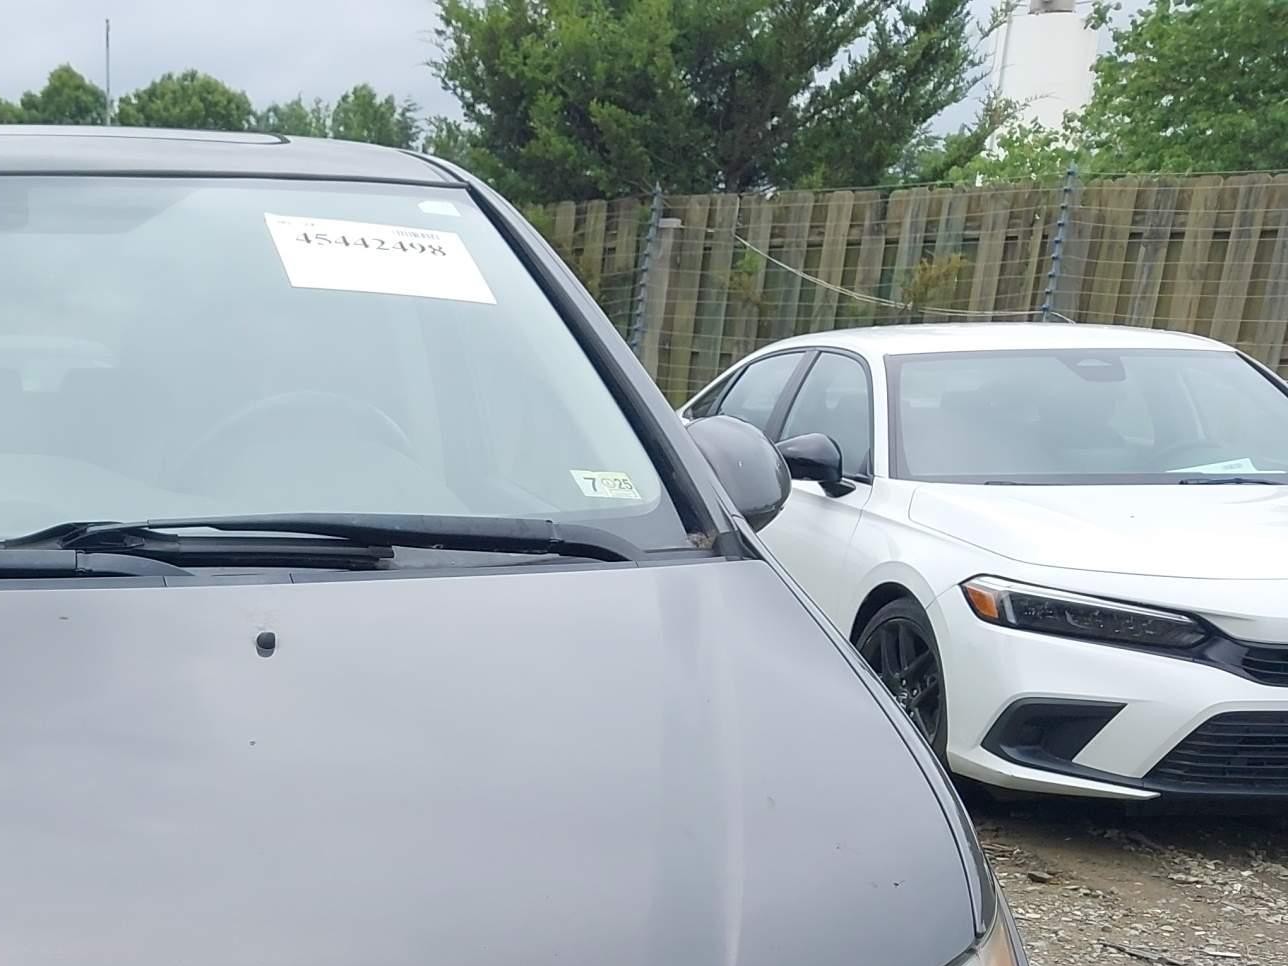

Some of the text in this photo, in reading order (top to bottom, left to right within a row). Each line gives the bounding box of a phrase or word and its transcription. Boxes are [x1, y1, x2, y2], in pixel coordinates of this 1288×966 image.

[295, 231, 448, 257] 45442498
[583, 477, 633, 493] 7 25
